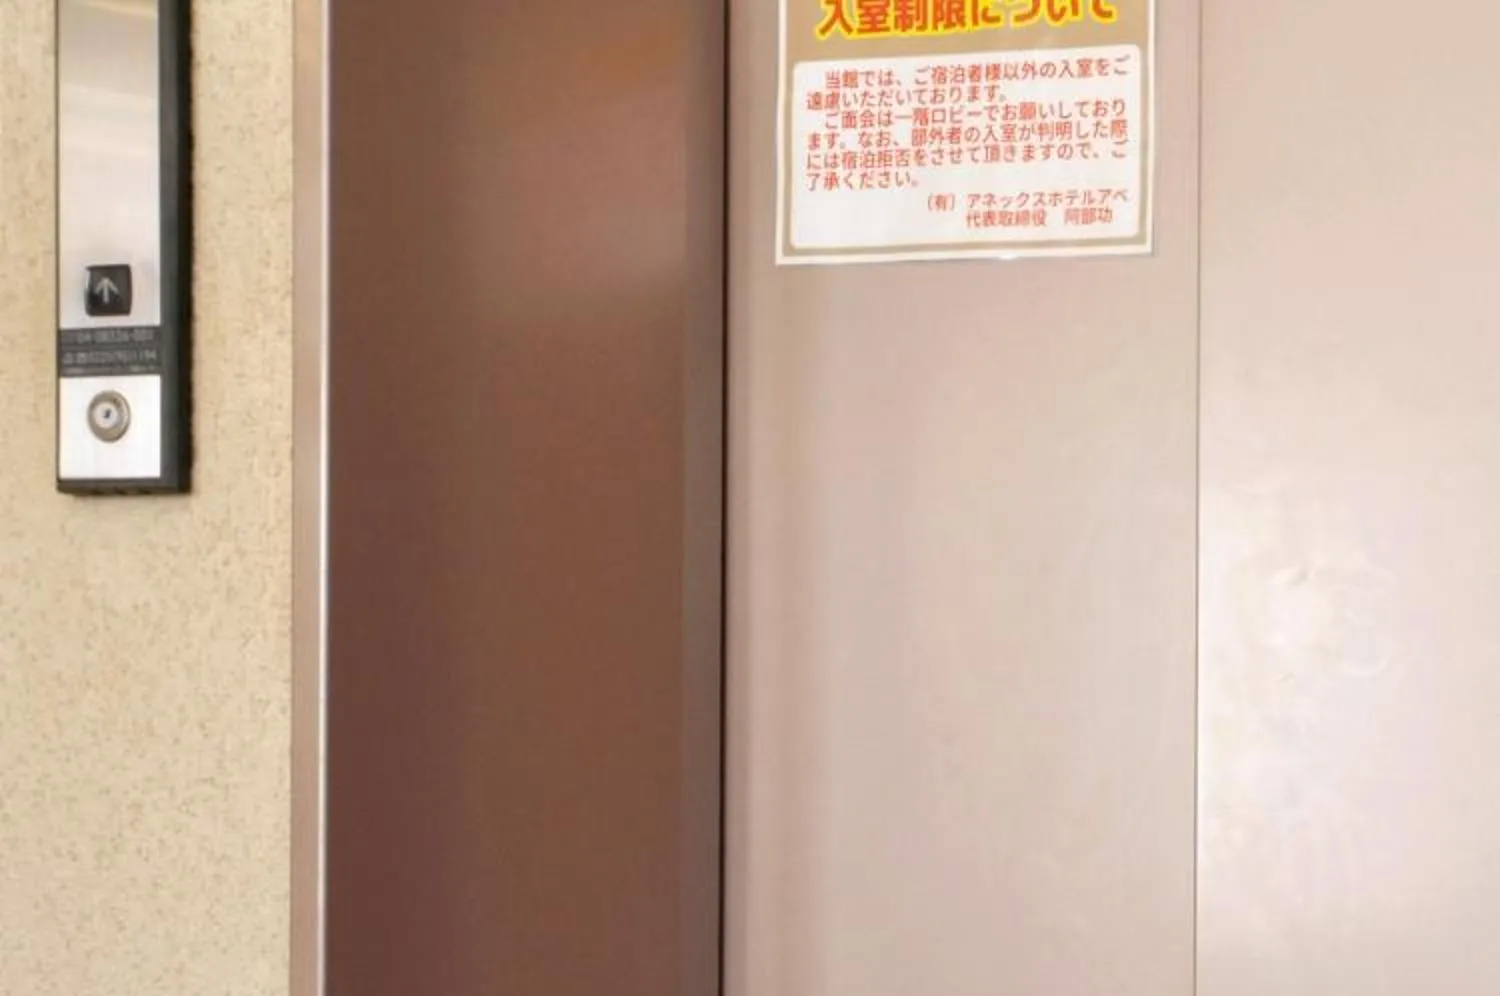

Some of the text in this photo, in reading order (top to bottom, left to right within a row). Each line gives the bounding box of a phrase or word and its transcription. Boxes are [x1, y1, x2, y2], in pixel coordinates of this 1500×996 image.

[825, 54, 1131, 90] 当館では、ご宿泊者様以外の入室をご
[807, 84, 1007, 110] 遠慮いただいております。
[825, 97, 1126, 130] ご面会は一階ロビーでお願いしており
[807, 171, 919, 192] 了承ください。
